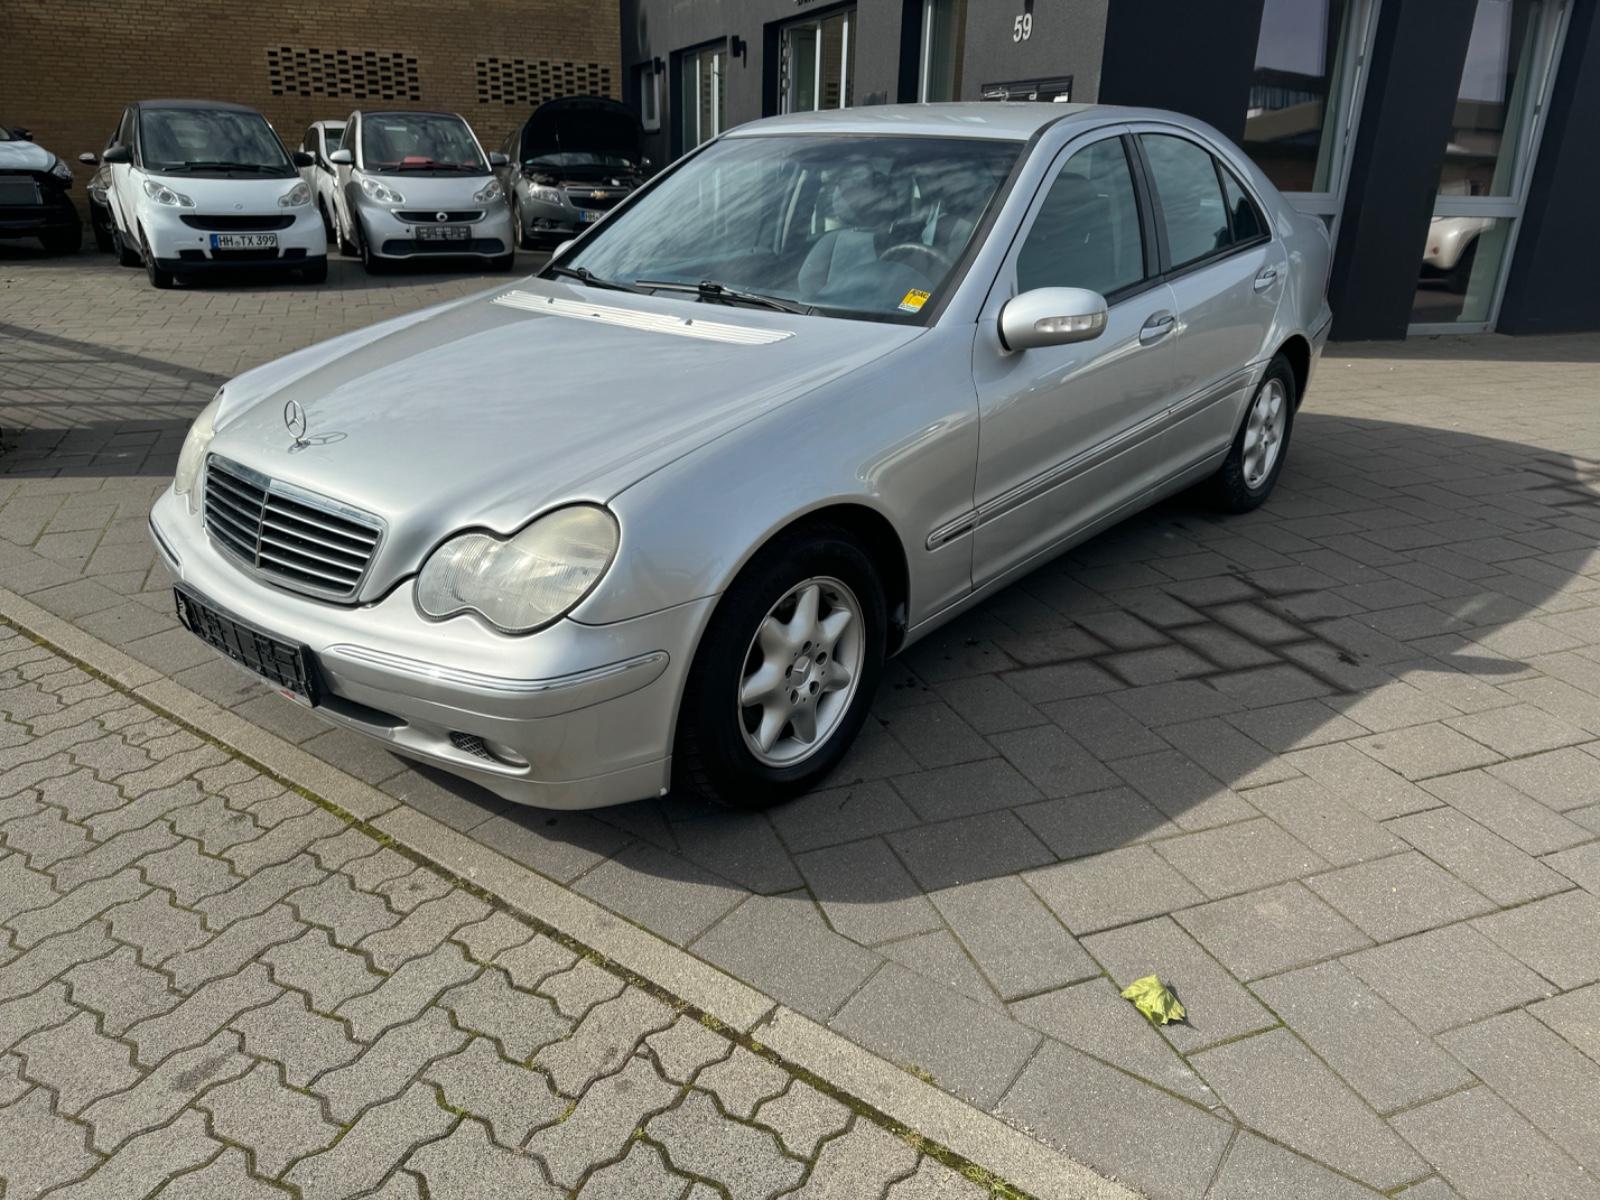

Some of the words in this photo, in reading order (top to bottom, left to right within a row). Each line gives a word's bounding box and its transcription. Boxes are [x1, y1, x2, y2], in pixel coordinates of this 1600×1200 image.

[1013, 13, 1033, 42] 59
[219, 235, 234, 246] HH
[240, 235, 254, 246] TX
[256, 235, 275, 246] 399
